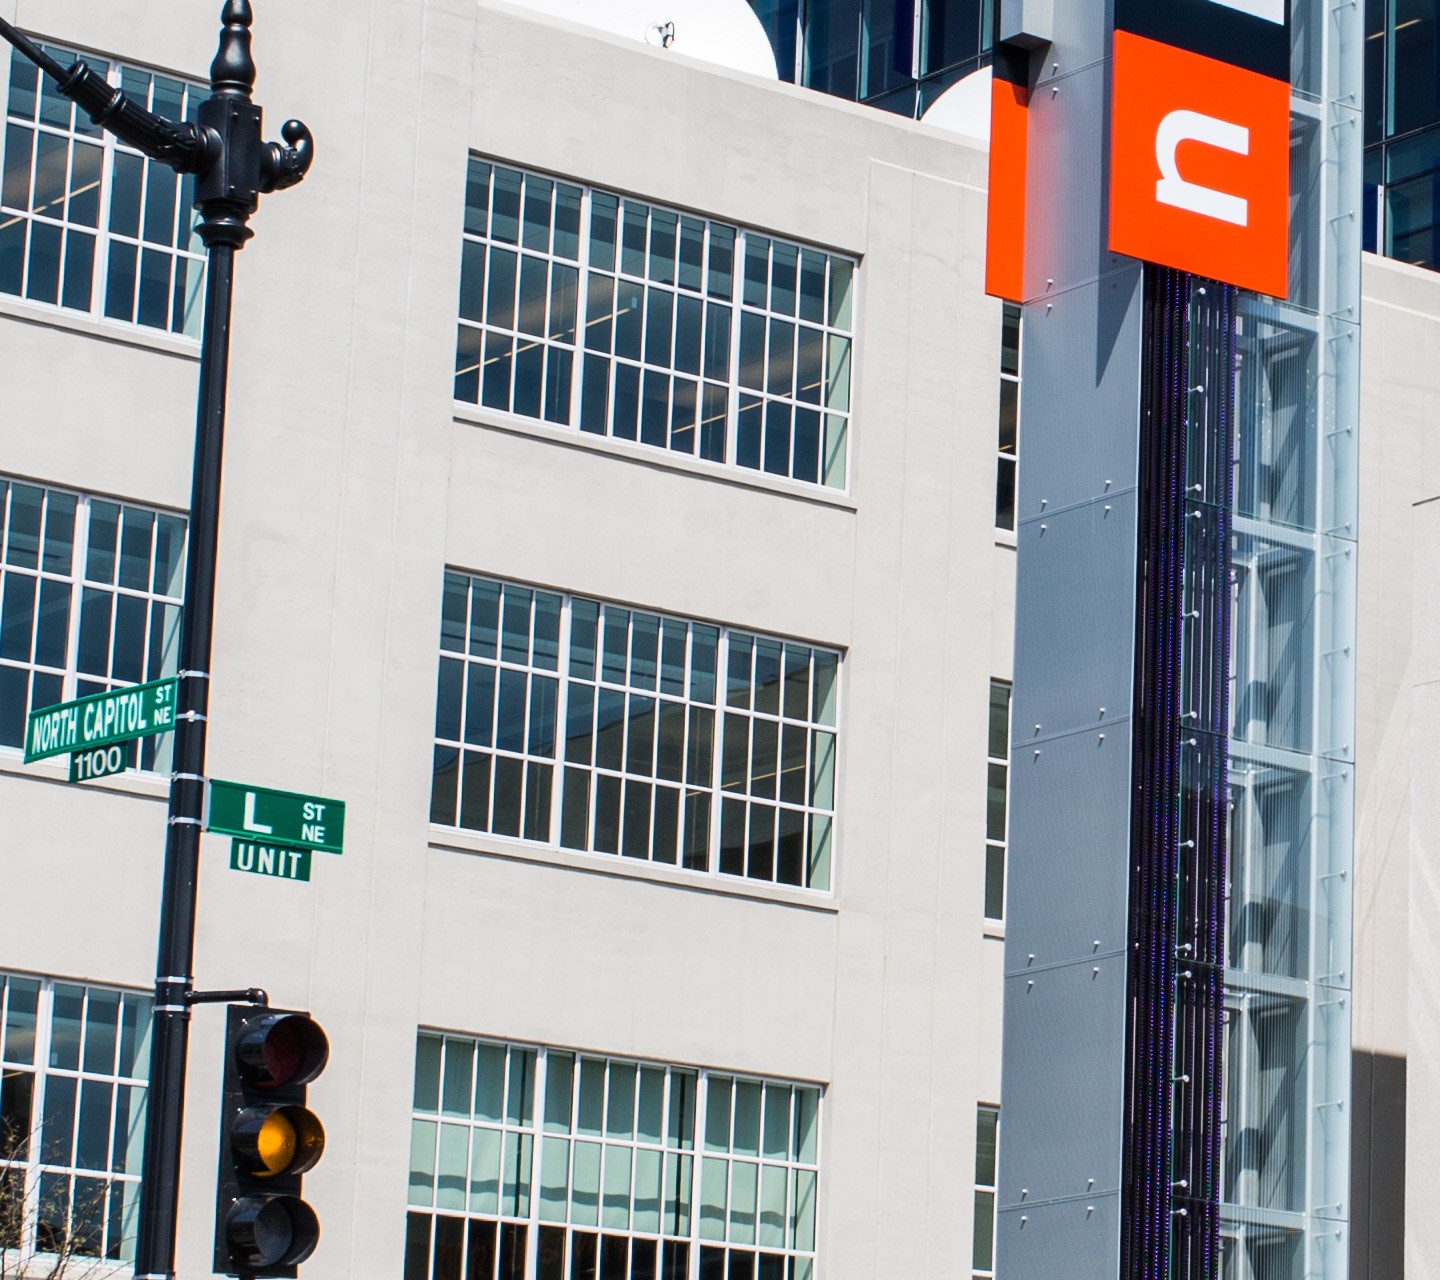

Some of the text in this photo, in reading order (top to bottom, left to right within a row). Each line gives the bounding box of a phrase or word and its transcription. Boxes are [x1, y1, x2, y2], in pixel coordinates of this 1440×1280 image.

[155, 684, 172, 705] ST
[31, 690, 147, 756] NORTH CAPITOL
[154, 707, 172, 726] NE
[74, 745, 122, 780] 1100
[243, 791, 273, 835] L
[302, 802, 326, 822] ST
[301, 823, 325, 844] NE
[236, 843, 303, 879] UNIT
